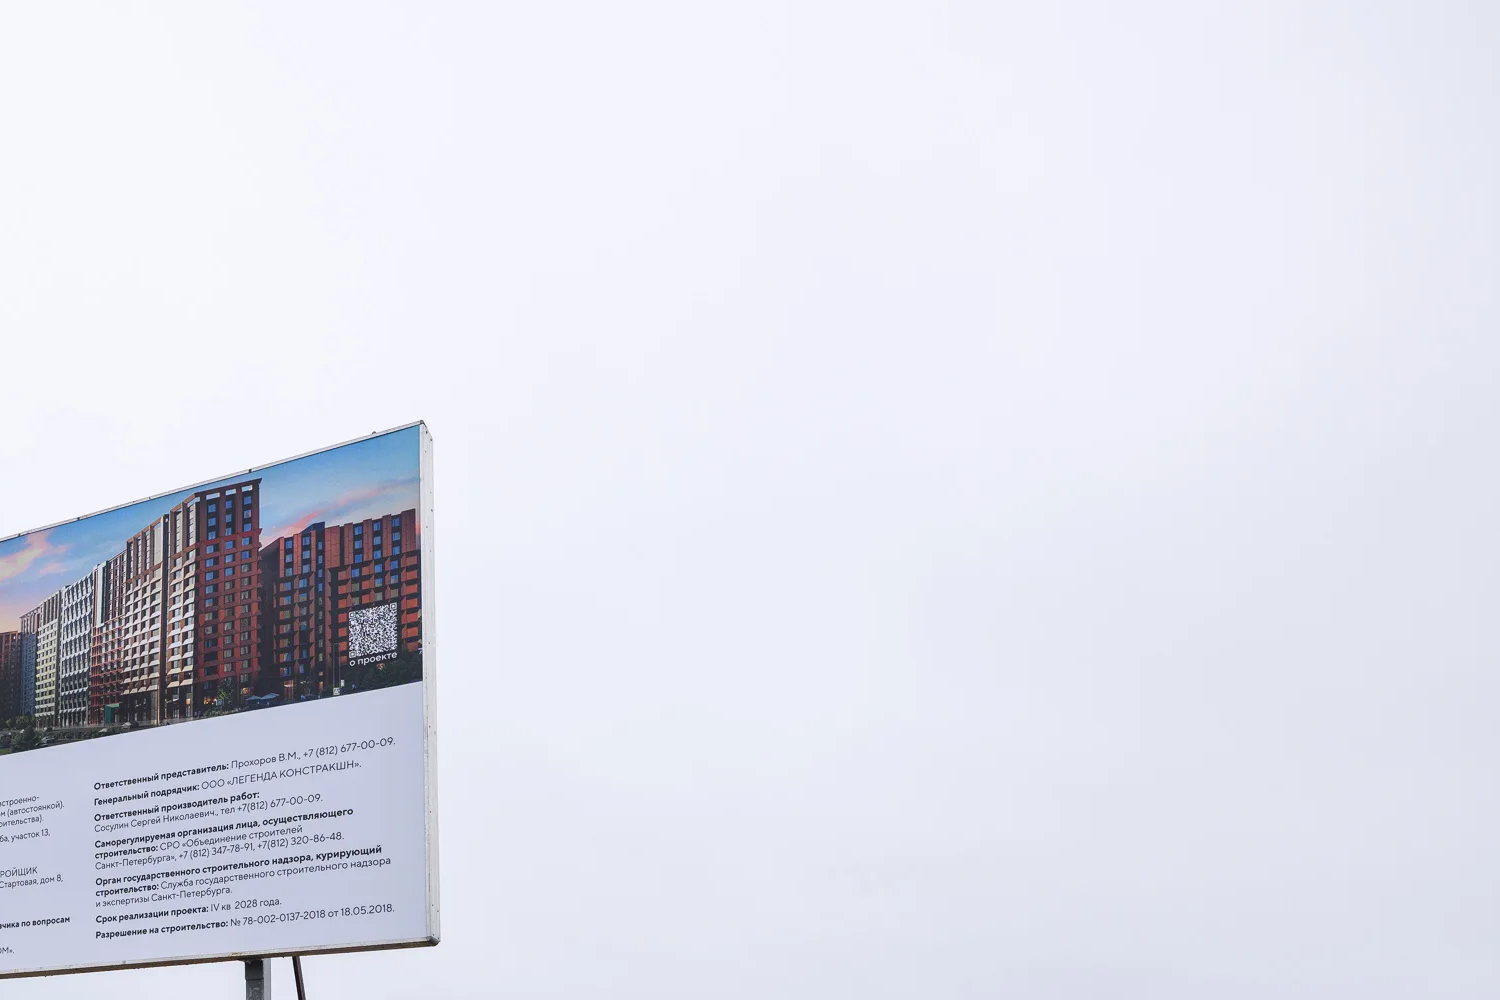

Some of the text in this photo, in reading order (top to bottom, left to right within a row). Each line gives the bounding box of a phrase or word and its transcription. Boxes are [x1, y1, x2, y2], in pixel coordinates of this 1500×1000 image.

[357, 652, 398, 666] проекте
[93, 736, 395, 790] Ответственный представитель: Прохоров В.М., +7 (812) 677-00-09.
[94, 760, 361, 806] Генеральный подрядчик: ООО «ЛЕГЕНДА КОНСТРАКШН».
[7, 800, 65, 818] (автостоянкой).
[94, 791, 259, 821] Ответственный производитель работ:
[94, 822, 129, 833] Сосулин
[130, 816, 161, 827] Сергей
[220, 807, 235, 815] тел
[237, 800, 268, 813] +7(812)
[270, 793, 323, 808] 677-00-09.
[10, 831, 40, 843] участок
[94, 808, 353, 848] Саморегулируемая организация лица, осуществляющего
[94, 824, 303, 860] строительство: СРО «Объединение строителей
[94, 831, 344, 870] Санкт-Петербурга», +7 (812) 347-78-91, +7(812) 320-86-48.
[95, 845, 381, 887] Орган государственного строительного надзора, курирующий
[39, 877, 55, 885] дом
[95, 857, 391, 898] строительство: Служба государственного строительного надзора
[95, 915, 117, 924] Срок
[118, 910, 169, 923] реализации
[171, 906, 208, 917] проекта:
[210, 903, 220, 912] IV
[235, 899, 258, 910] 2028
[259, 898, 282, 907] года.
[102, 896, 149, 907] экспертизы
[151, 887, 232, 902] Санкт-Петербурга.
[32, 917, 70, 926] вопросам
[95, 928, 147, 939] Разрешение
[161, 921, 228, 934] строительство:
[230, 918, 241, 926] №
[243, 909, 326, 925] 78-002-0137-2018
[328, 910, 339, 918] от
[341, 903, 394, 916] 18.05.2018.
